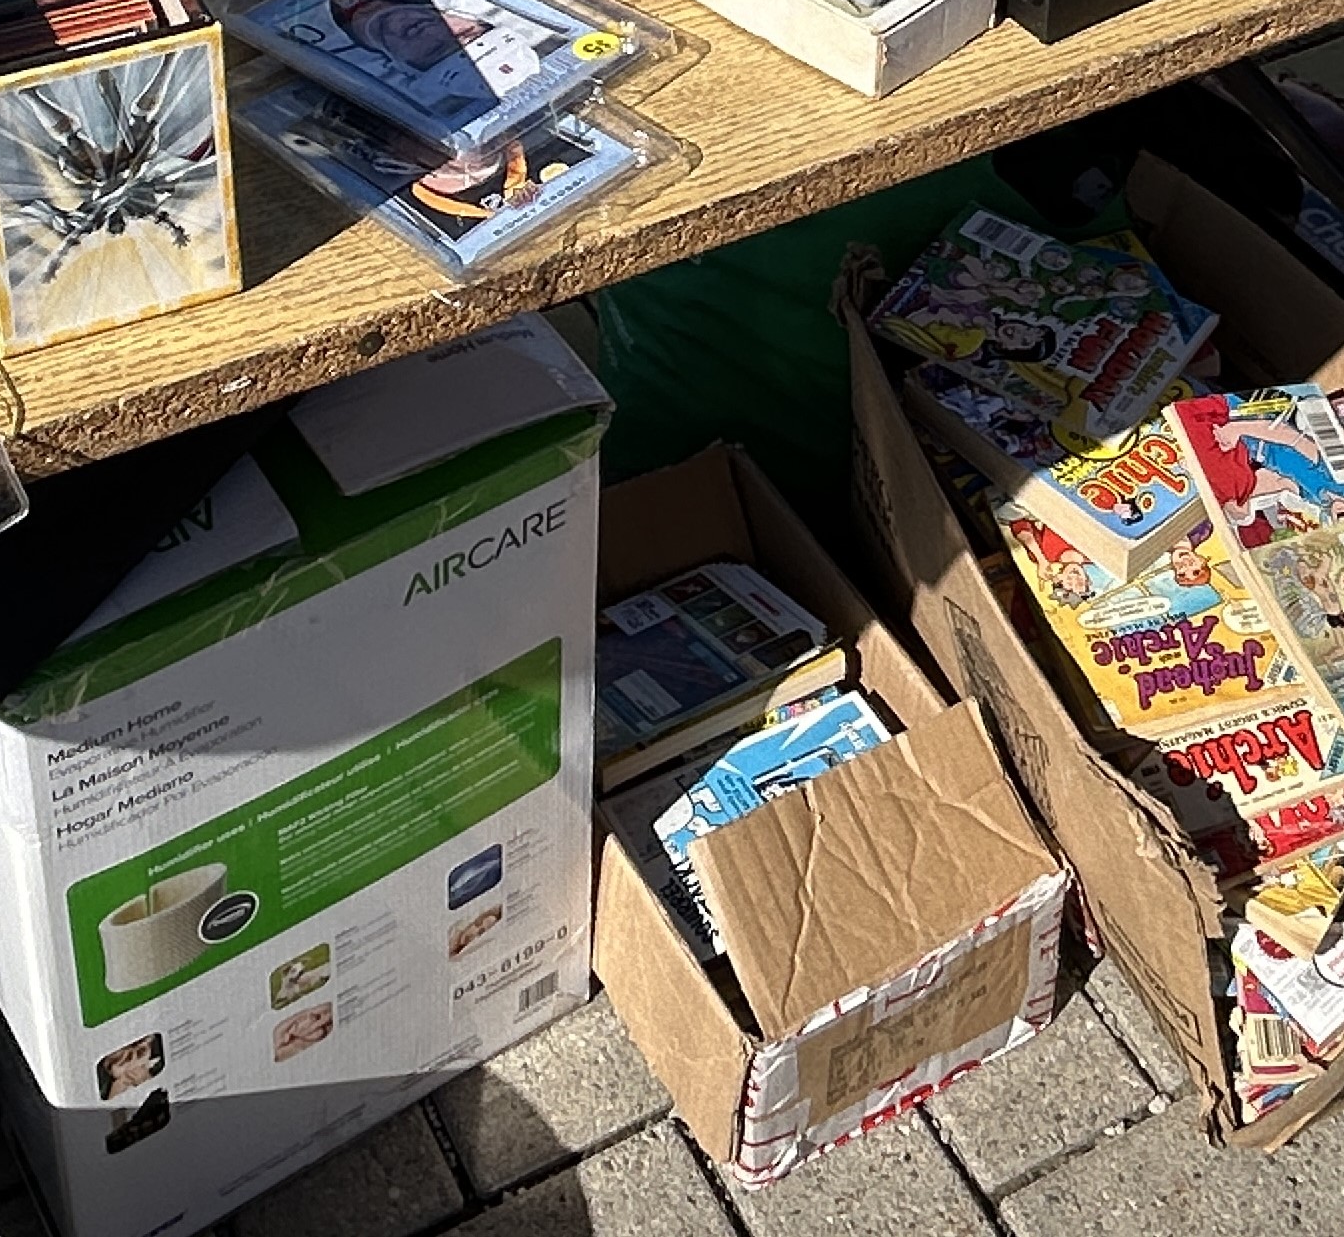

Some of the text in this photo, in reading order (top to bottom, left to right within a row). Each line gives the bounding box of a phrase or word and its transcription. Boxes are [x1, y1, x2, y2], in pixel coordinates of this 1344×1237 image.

[1076, 433, 1191, 514] chie
[401, 499, 569, 607] AIRCARE
[1090, 614, 1220, 676] Archie
[1133, 638, 1266, 711] Jughead
[47, 700, 183, 767] Medium Home
[140, 700, 215, 742] Humidifier
[1162, 708, 1327, 798] Archie
[52, 715, 230, 803] La Maison Moyenne
[56, 804, 114, 838] Hogar
[147, 837, 214, 877] Humidifier
[216, 824, 246, 844] uses
[256, 772, 344, 823] Humidificateur
[164, 789, 188, 806] Por
